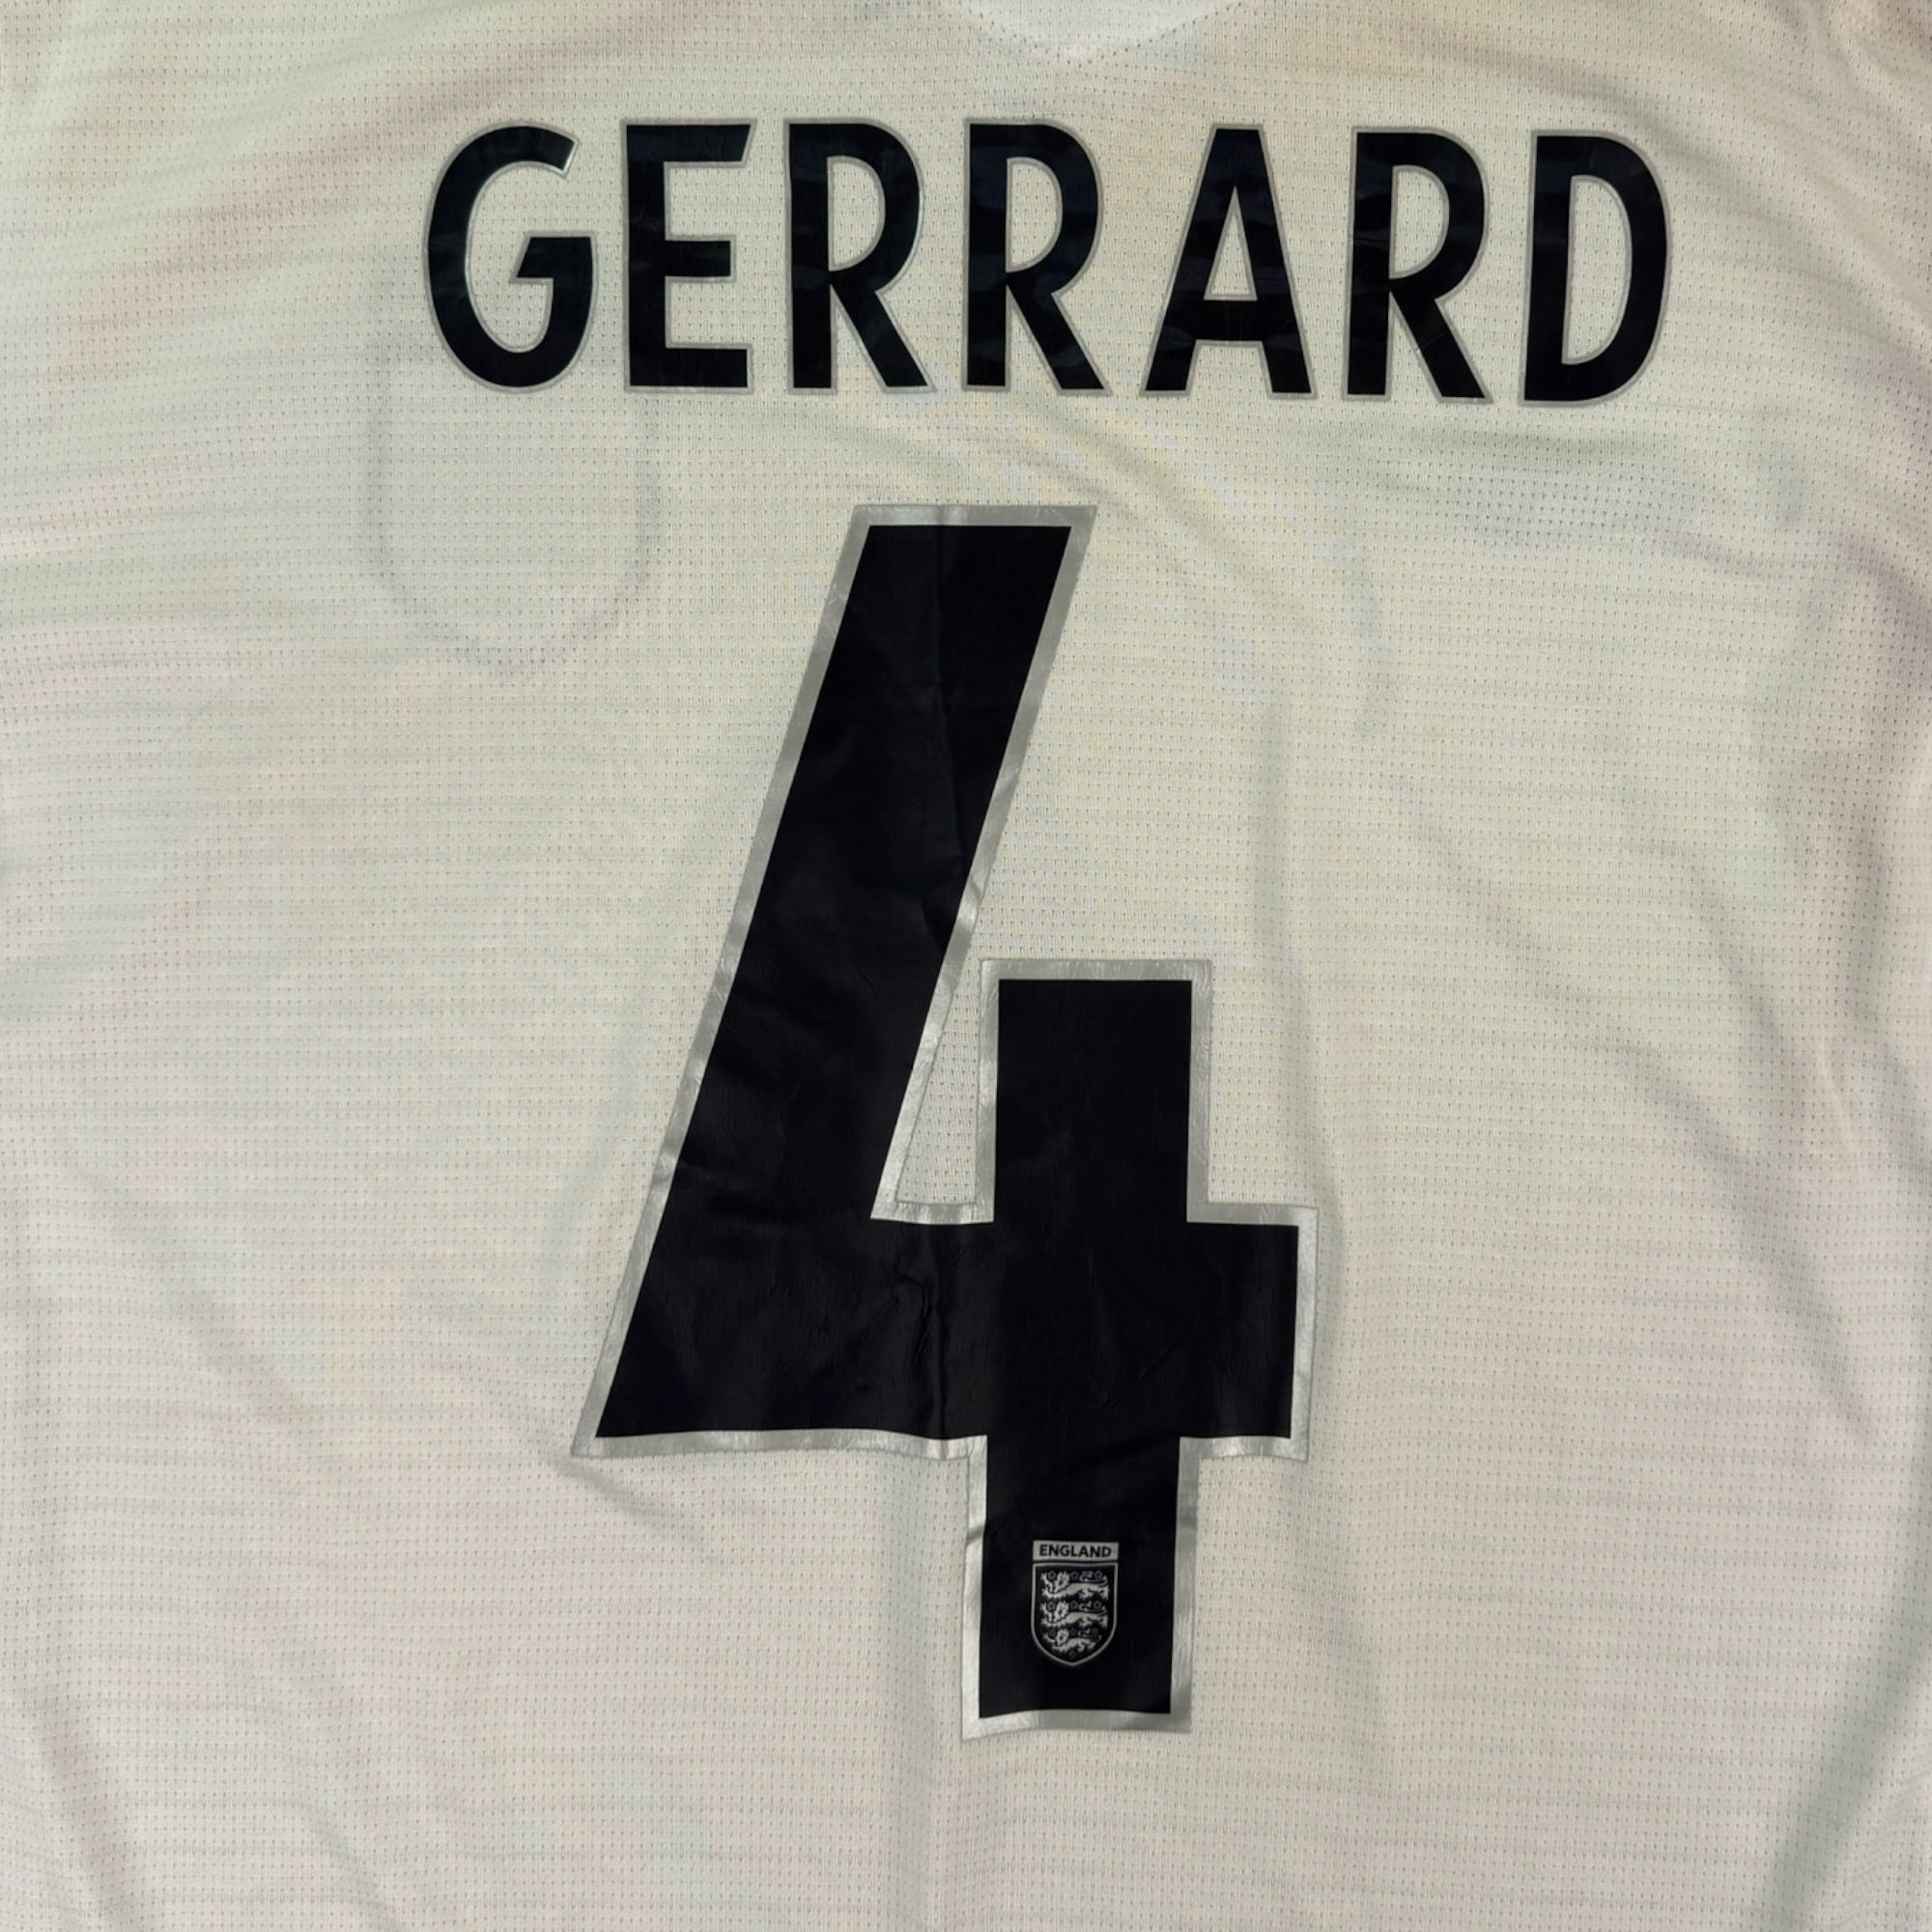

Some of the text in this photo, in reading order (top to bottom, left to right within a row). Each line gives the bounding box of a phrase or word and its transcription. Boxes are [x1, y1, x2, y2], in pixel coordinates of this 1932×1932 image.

[425, 119, 1669, 404] GERRARD
[574, 505, 1318, 1739] 4
[1038, 1544, 1112, 1558] ENGLAND
